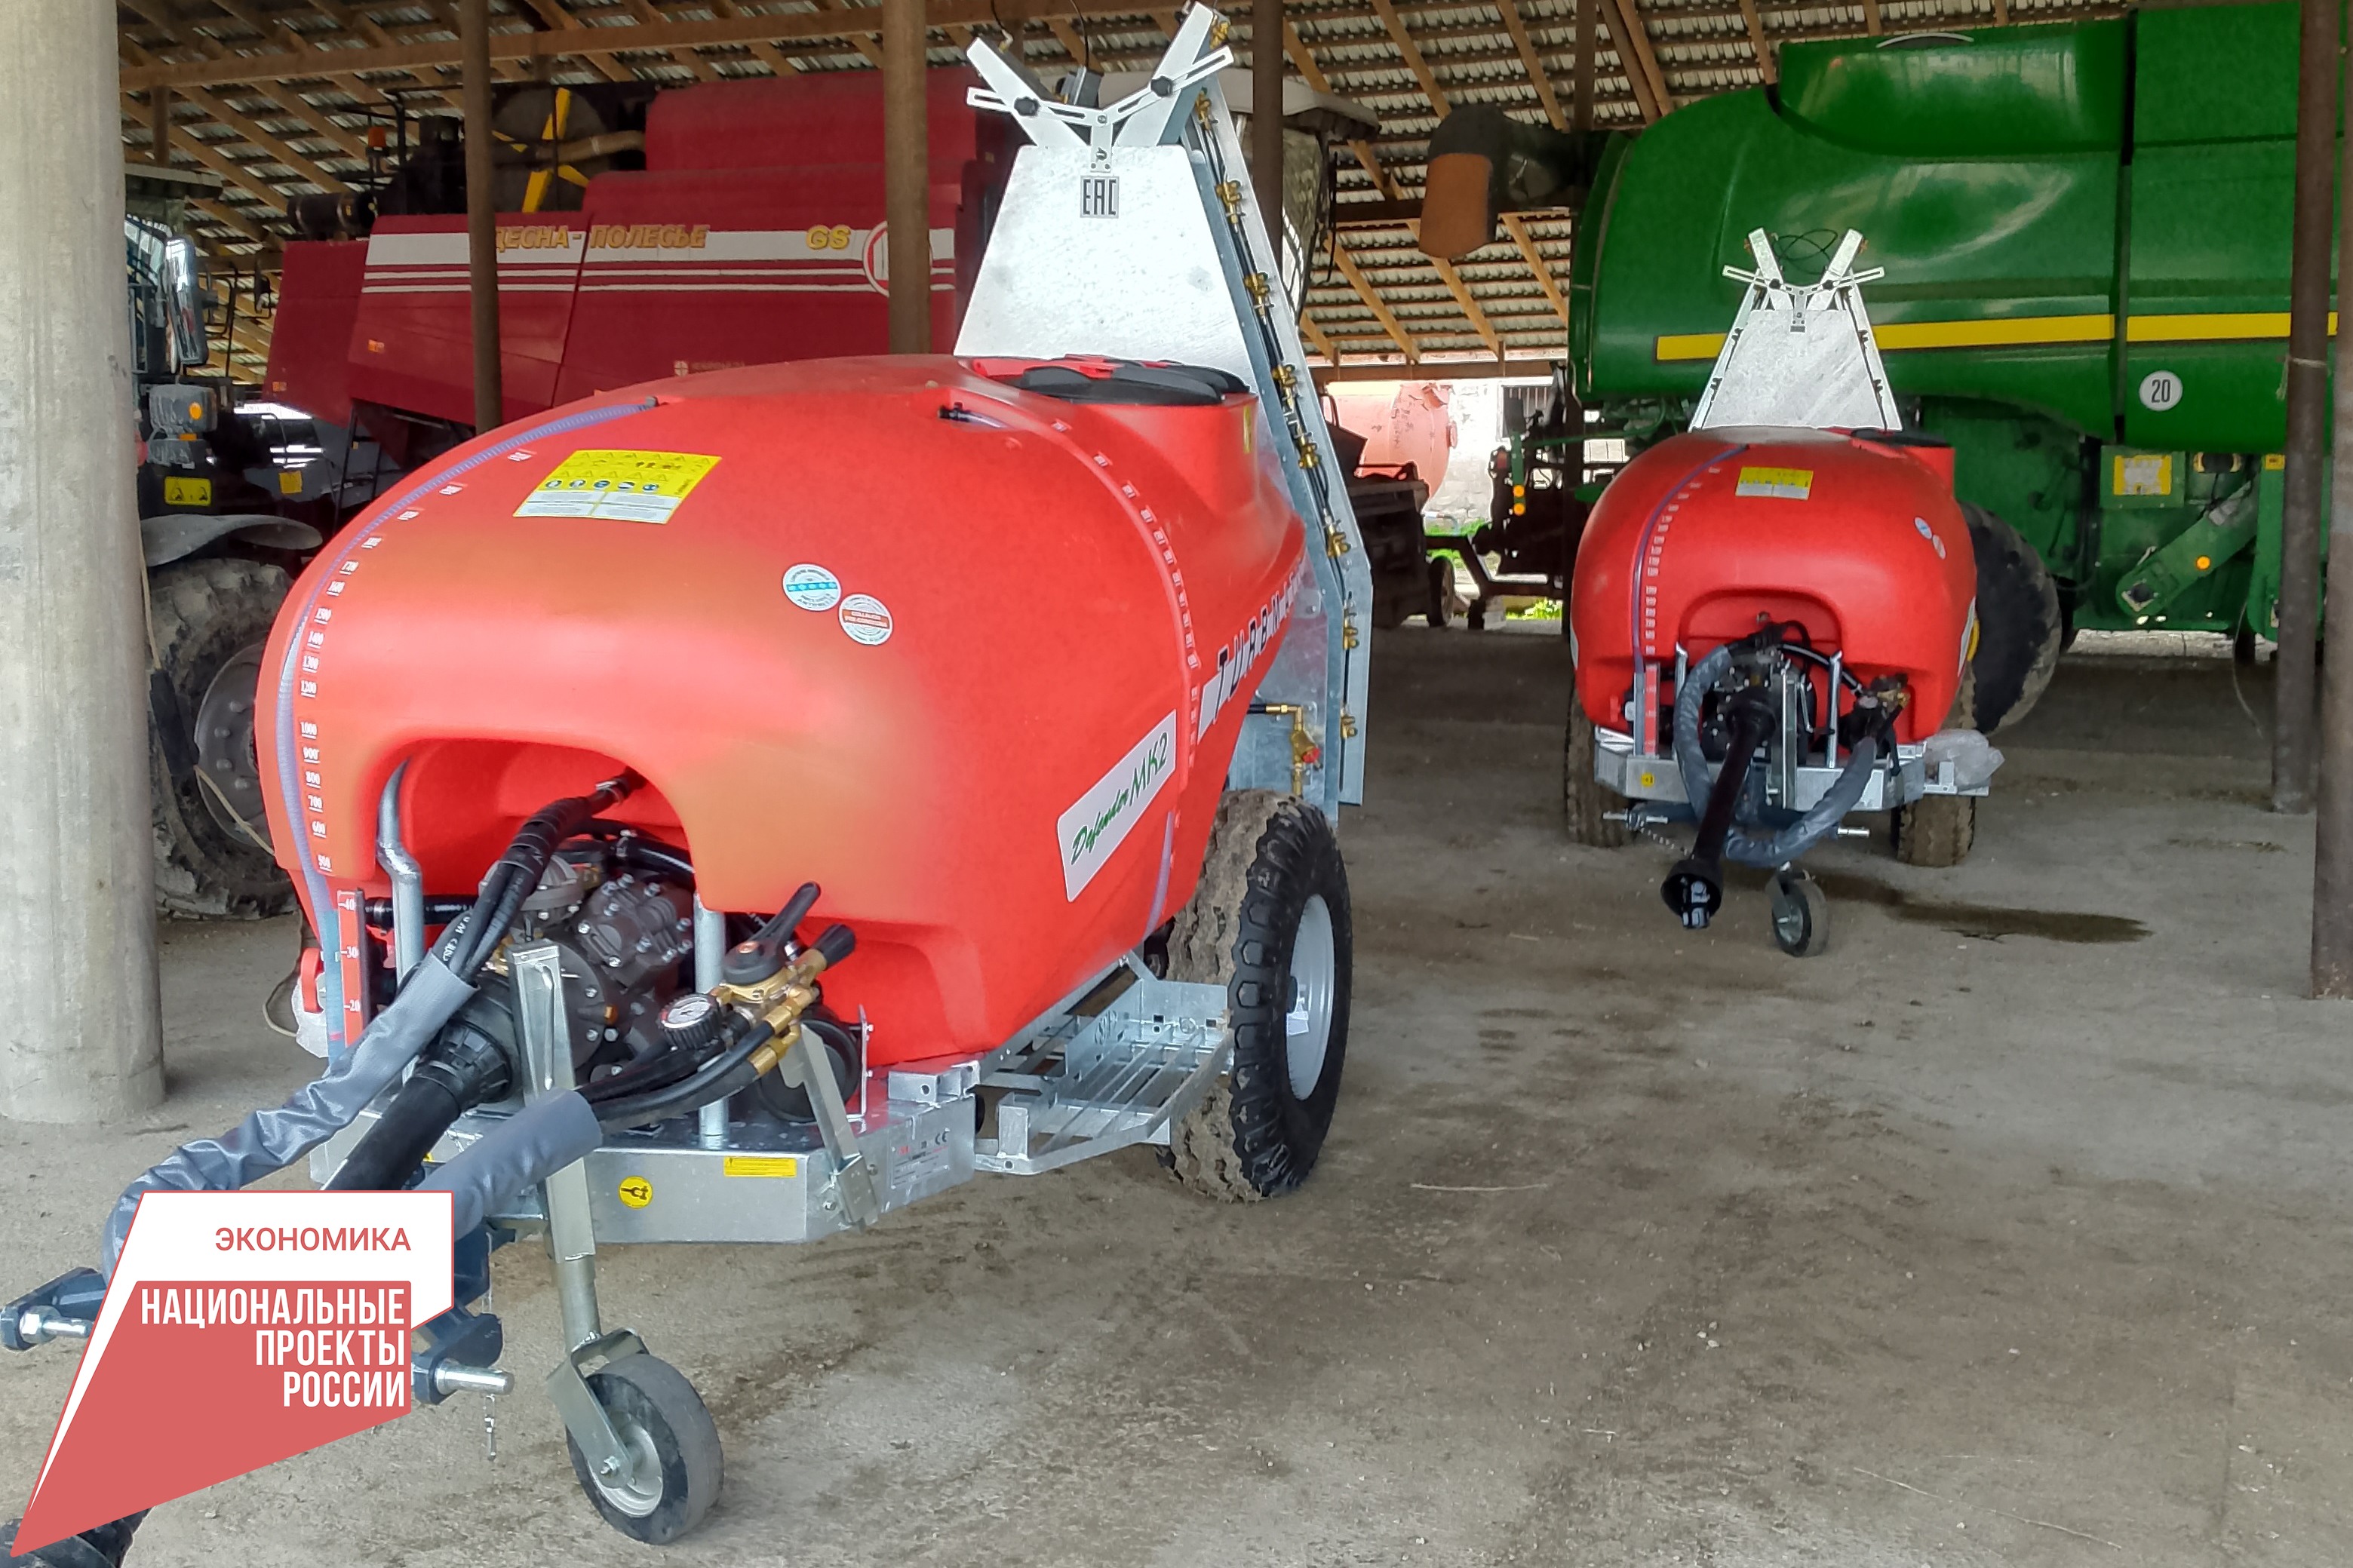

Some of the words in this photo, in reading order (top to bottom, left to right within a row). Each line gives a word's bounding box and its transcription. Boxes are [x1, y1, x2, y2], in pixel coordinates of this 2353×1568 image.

[1083, 179, 1117, 216] EAC
[590, 224, 710, 249] ПОЛЕСЬЕ
[806, 224, 852, 250] GS
[2151, 379, 2170, 404] 20
[300, 721, 318, 735] 1000
[306, 771, 321, 785] 800
[1129, 732, 1169, 807] MK2
[308, 795, 323, 809] 700
[346, 946, 359, 959] 30
[349, 999, 361, 1012] 20
